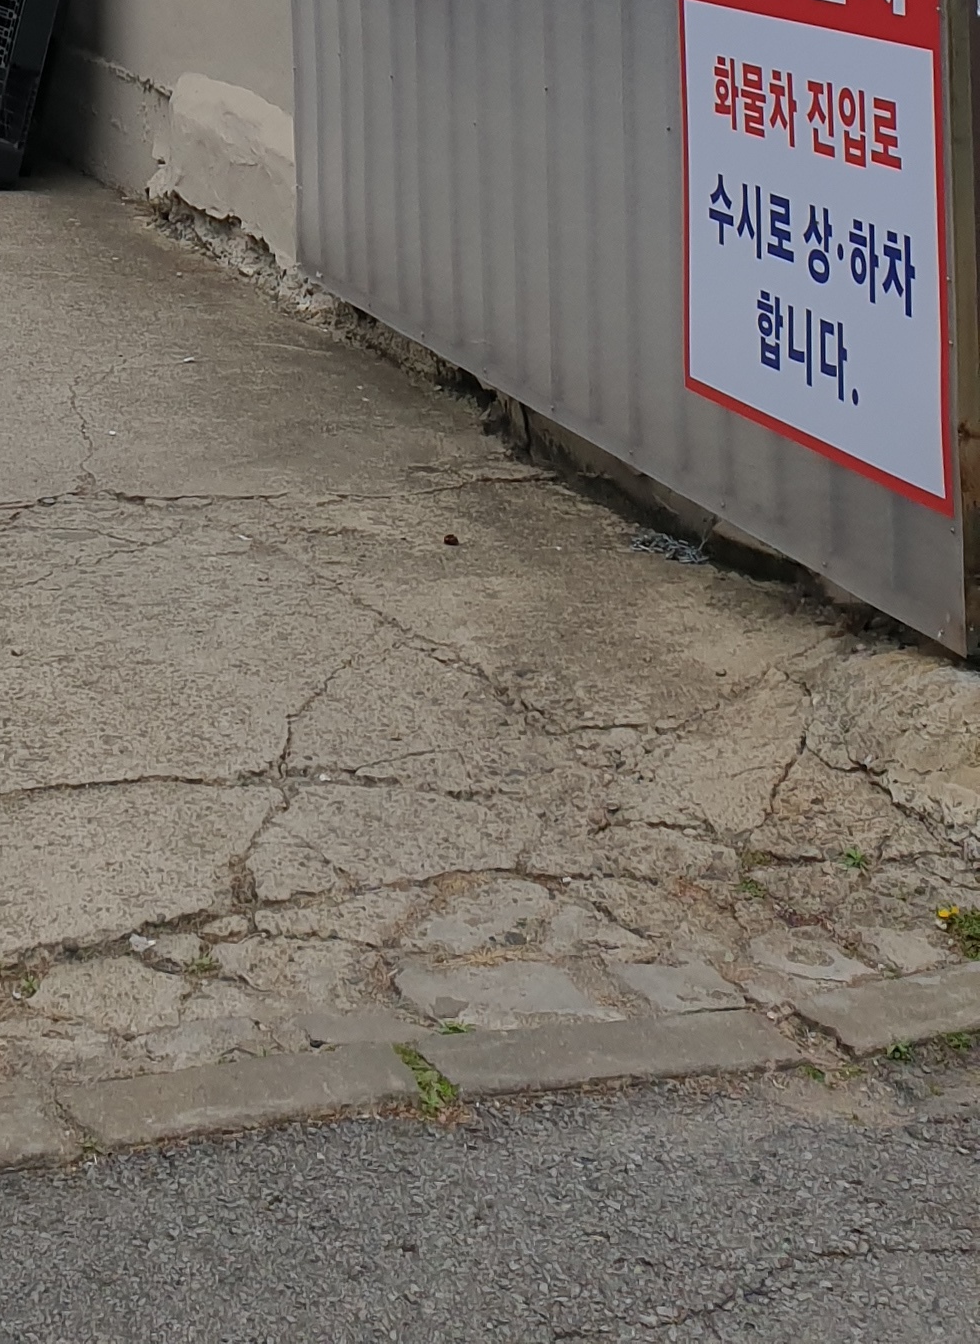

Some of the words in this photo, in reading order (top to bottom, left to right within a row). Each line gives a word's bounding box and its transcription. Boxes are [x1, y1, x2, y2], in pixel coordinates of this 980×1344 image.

[713, 55, 797, 148] 화물차
[806, 79, 903, 171] 진입로
[708, 173, 795, 263] 수시로
[757, 289, 860, 407] 합니다.
